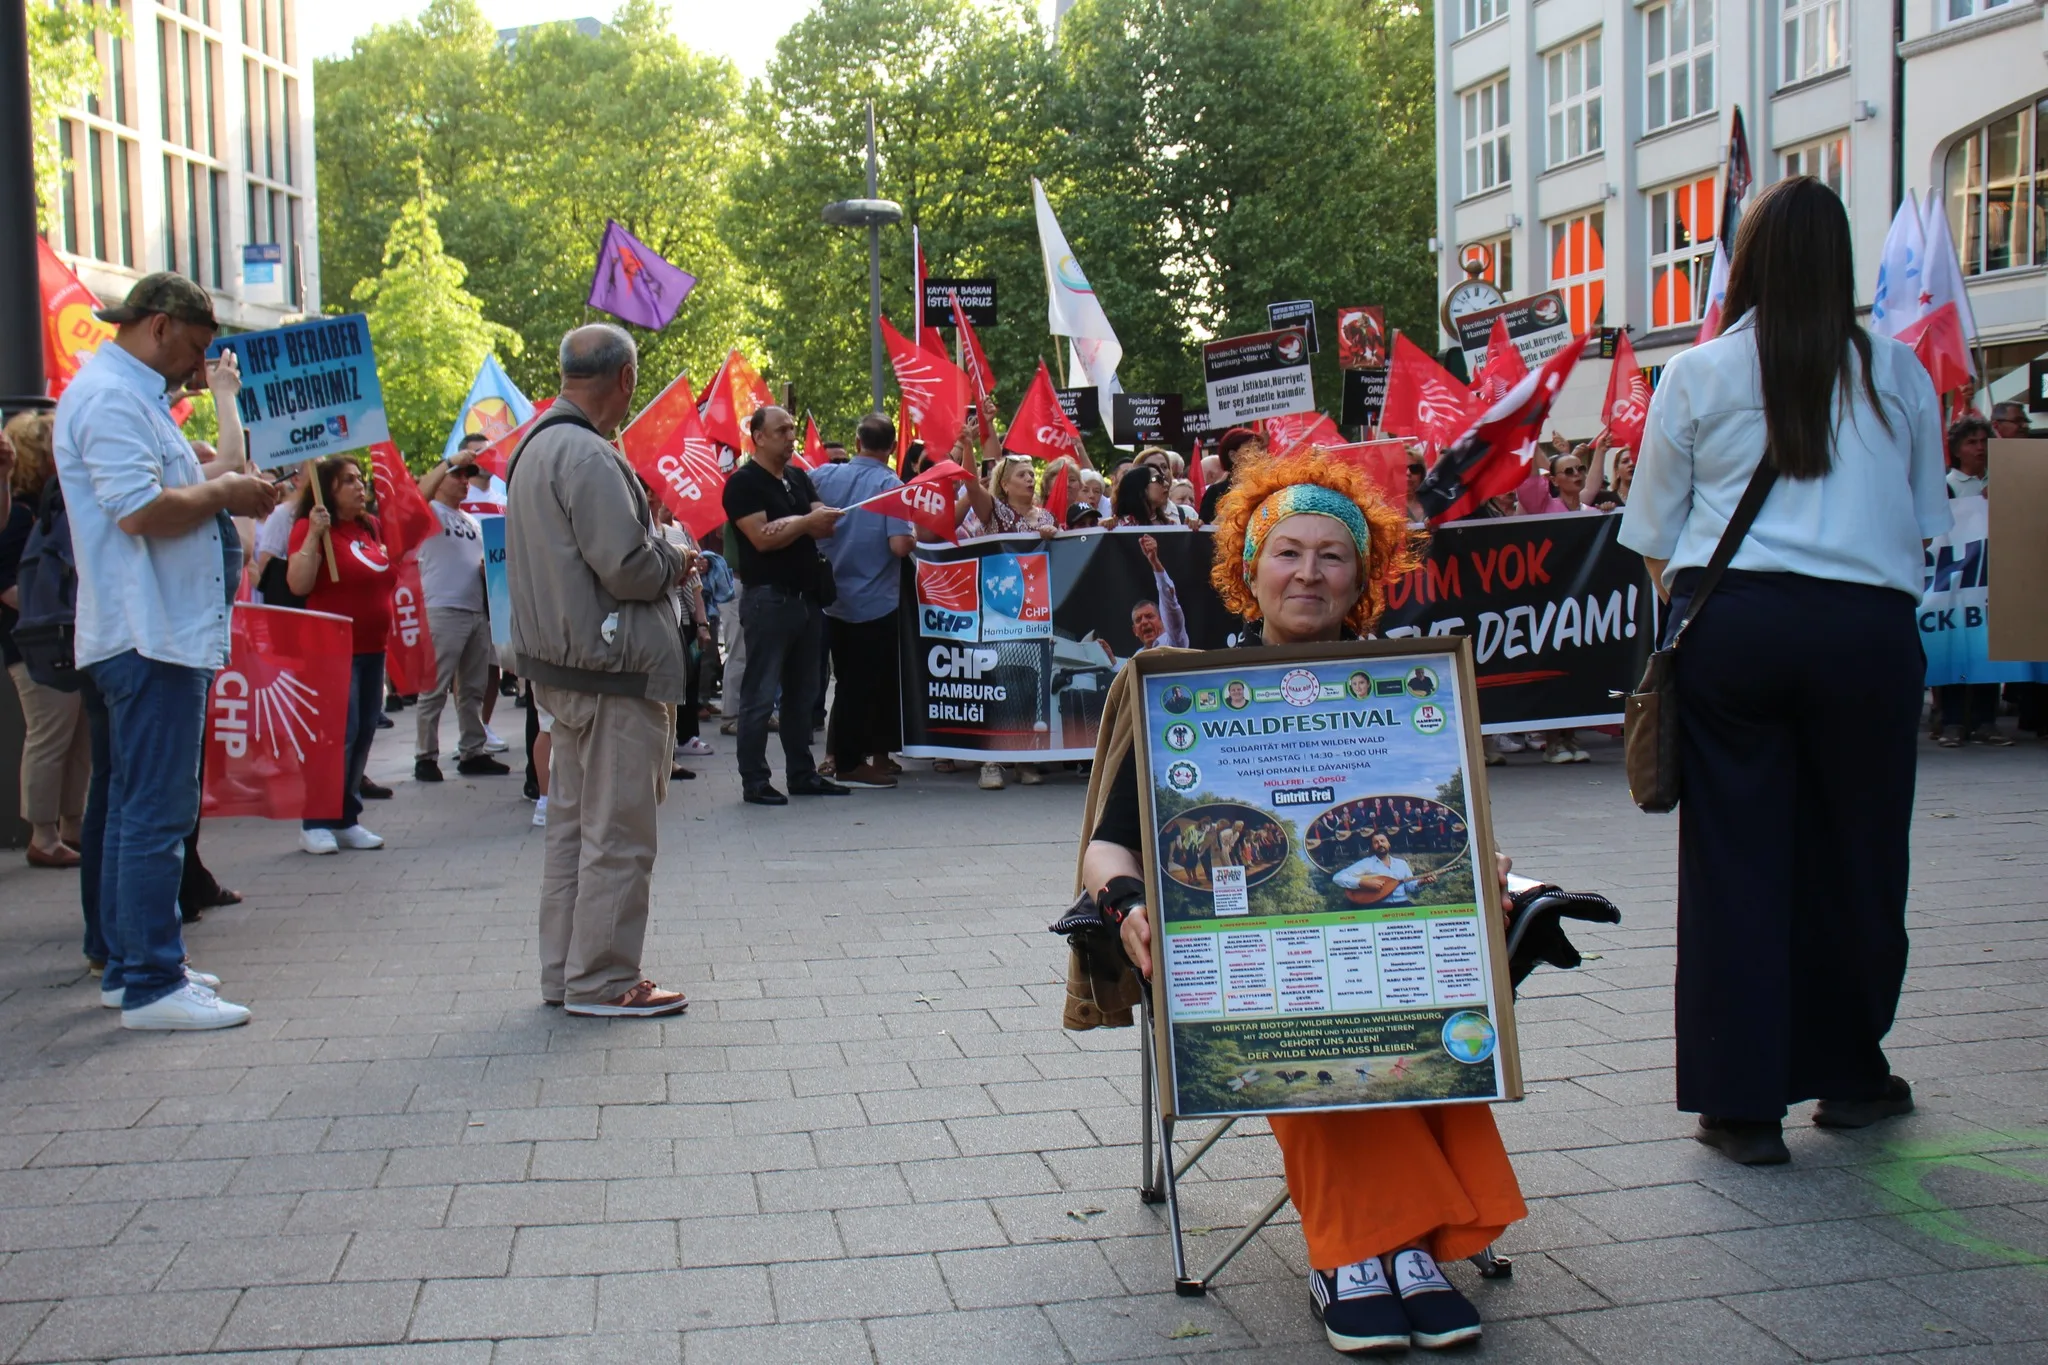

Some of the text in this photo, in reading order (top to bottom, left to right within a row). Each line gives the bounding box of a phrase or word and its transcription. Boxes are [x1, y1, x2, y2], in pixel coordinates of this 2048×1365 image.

[960, 286, 992, 295] BAŞKAN
[246, 336, 280, 374] HEP
[284, 321, 362, 367] BERABER
[1240, 342, 1272, 354] Gemeinde
[1212, 354, 1258, 370] Hamburg-Mitte
[264, 361, 362, 420] HİÇBİRİMİZ
[1218, 400, 1230, 410] Her
[1232, 399, 1244, 409] şey
[1246, 393, 1274, 404] adaletle
[1236, 402, 1290, 417] Mustafa Kemal Atatürk
[1136, 406, 1160, 416] OMUZ
[1612, 398, 1644, 427] CH
[1134, 417, 1162, 426] OMUZA
[290, 424, 325, 445] CHP
[270, 445, 304, 458] HAMBURG
[657, 455, 702, 501] CHP
[900, 485, 946, 515] CHP
[1472, 538, 1552, 593] YOK
[924, 609, 974, 632] CHP
[1026, 607, 1048, 618] CHP
[984, 624, 1050, 636] Hamburg Birliği
[1477, 584, 1637, 664] DEVAM!
[928, 645, 998, 680] CHP
[928, 682, 1006, 701] HAMBURG
[214, 671, 248, 758] CHP
[928, 702, 984, 722] BİRLİĞİ
[1202, 709, 1401, 738] WALDFESTIVAL
[1220, 742, 1278, 754] SOLIDARITÄT
[1299, 740, 1319, 748] DEM
[1321, 738, 1356, 746] WILDEN
[1358, 736, 1385, 744] WALD
[1258, 754, 1300, 764] SAMSTAG
[1237, 767, 1264, 777] VAHŞİ
[1266, 767, 1300, 776] ORMAN
[1303, 765, 1315, 773] İLE
[1264, 775, 1346, 787] MÜLLFREI ÇÖPSÜZ
[1275, 790, 1331, 805] Eintritt Frei
[1224, 1022, 1258, 1032] HEKTAR
[1260, 1021, 1294, 1030] BIOTOP
[1300, 1018, 1333, 1027] WILDER
[1334, 1016, 1360, 1025] WALD
[1372, 1012, 1444, 1023] WILHELMSBURG,
[1258, 1031, 1281, 1039] 2000
[1283, 1028, 1322, 1038] BÄUMEN
[1341, 1026, 1385, 1034] TAUSENDEN
[1386, 1024, 1415, 1032] TIEREN
[1280, 1035, 1379, 1048] GEHÖRT UNS ALLEN!
[1248, 1043, 1416, 1060] DER WILDE WALD MUSS BLEIBEN.
